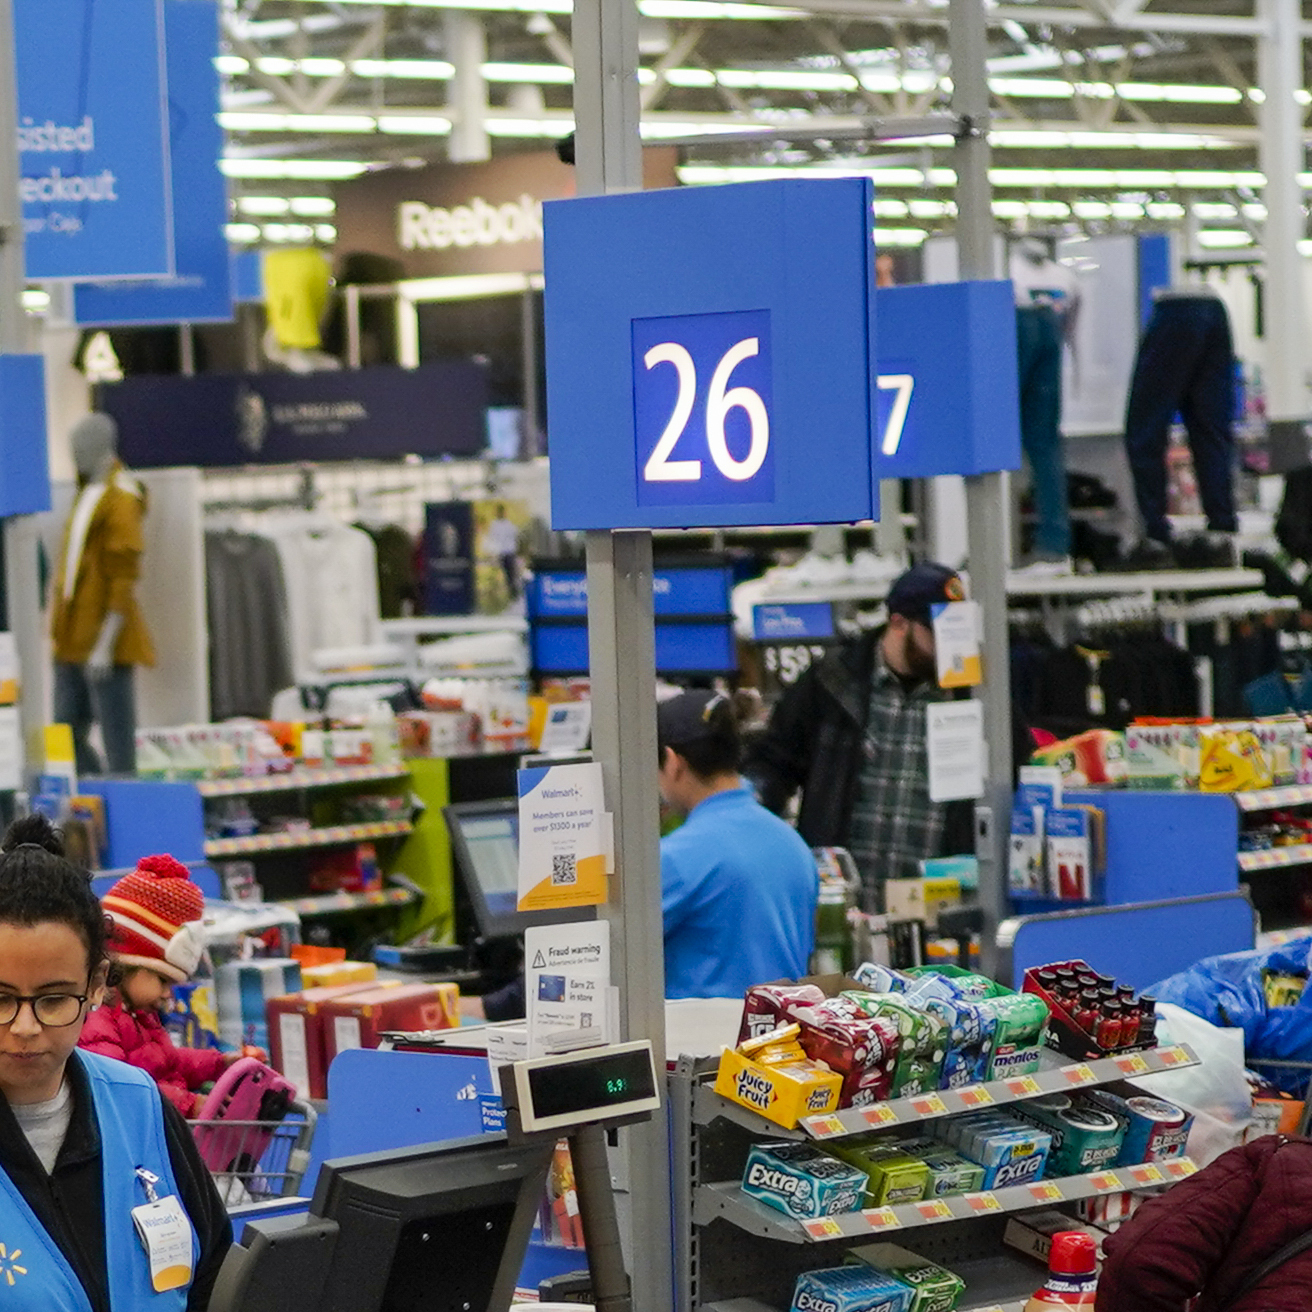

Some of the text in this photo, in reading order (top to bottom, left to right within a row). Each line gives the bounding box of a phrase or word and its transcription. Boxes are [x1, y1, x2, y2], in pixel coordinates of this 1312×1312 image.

[642, 337, 770, 481] 26
[541, 786, 575, 800] Walmart
[532, 806, 594, 821] Members can save
[533, 823, 549, 833] over
[549, 818, 572, 832] $1300
[548, 943, 601, 957] Fraud warning
[570, 979, 595, 990] Earn 2%
[569, 992, 593, 1002] in store
[993, 1049, 1039, 1067] mentos
[737, 1070, 773, 1093] Juicy
[737, 1083, 772, 1109] Fruit
[811, 1087, 831, 1100] Juicy
[808, 1096, 829, 1109] Fruit
[483, 1117, 502, 1127] Plans
[748, 1162, 799, 1193] Extra
[995, 1155, 1044, 1188] Extra
[905, 1266, 941, 1283] Extra
